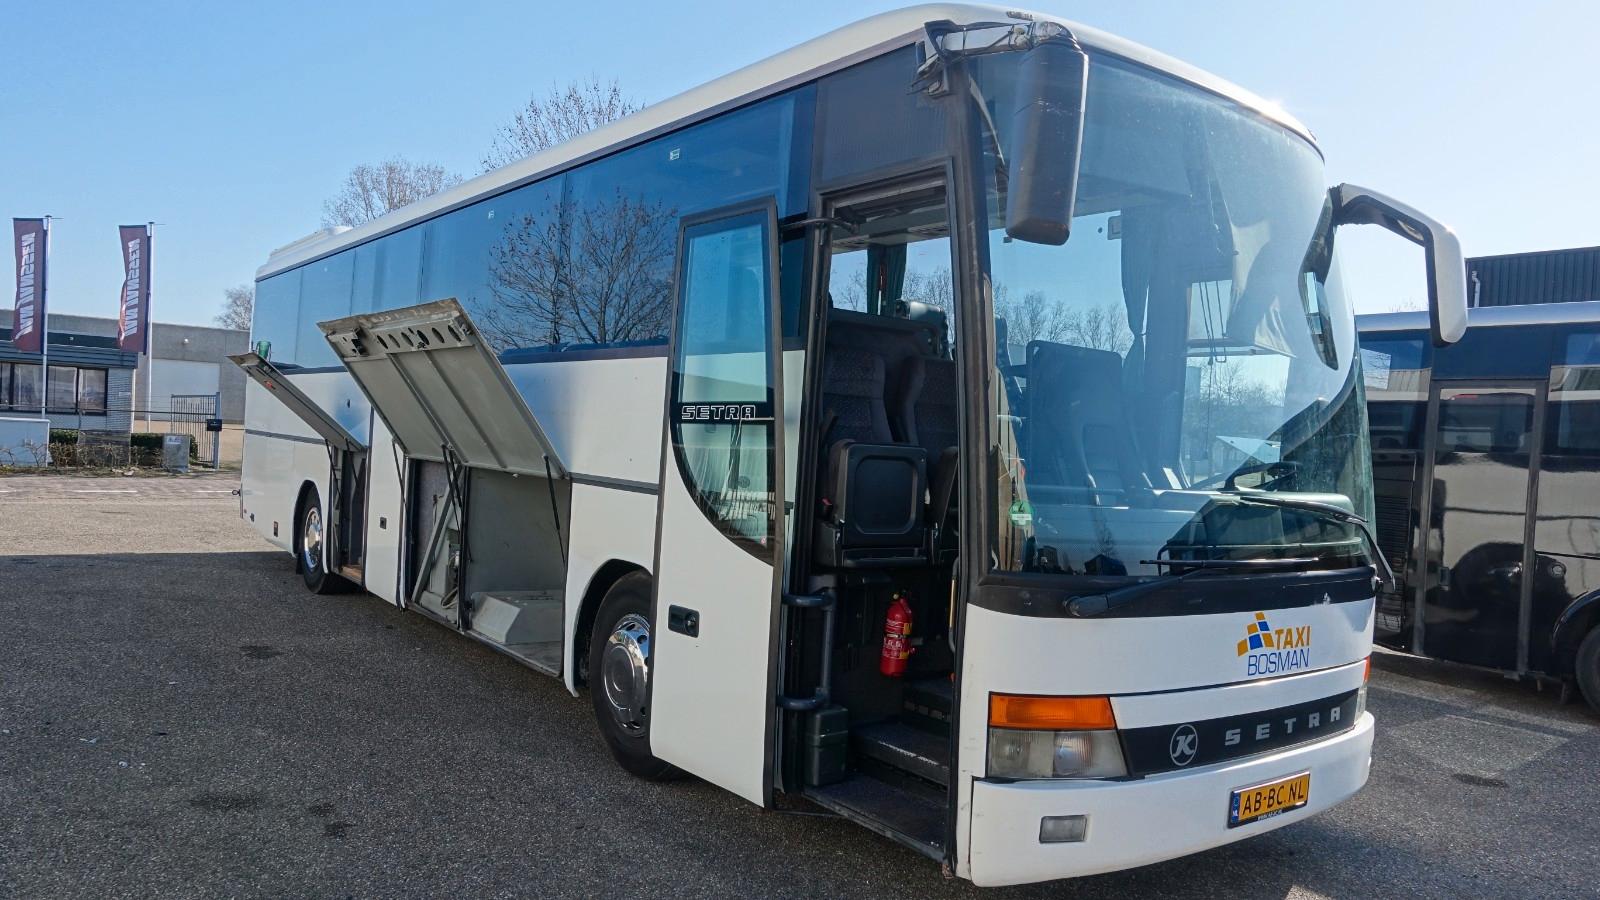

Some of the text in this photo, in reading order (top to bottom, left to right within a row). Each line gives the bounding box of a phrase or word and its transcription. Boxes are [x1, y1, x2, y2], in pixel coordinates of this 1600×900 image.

[681, 404, 756, 420] SETRA
[1274, 624, 1311, 651] TAXI
[1247, 648, 1309, 676] BOSMAN
[1224, 706, 1341, 745] SETRA
